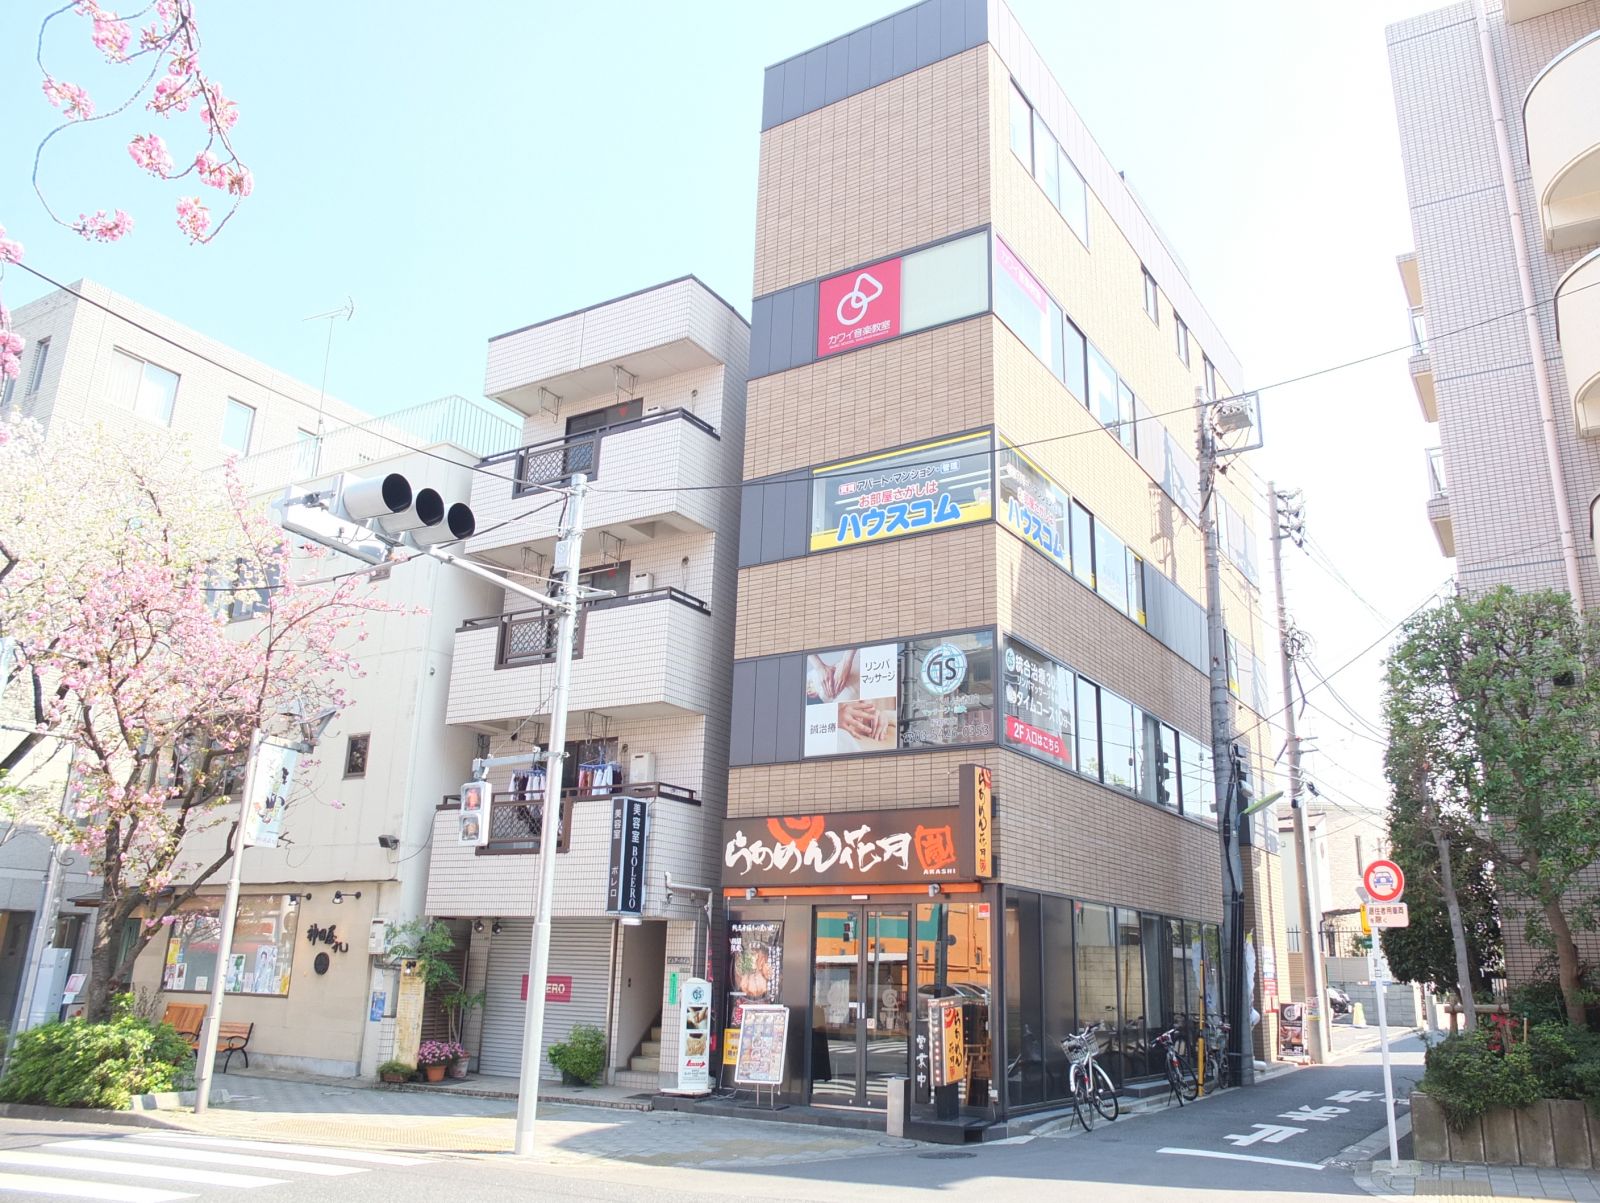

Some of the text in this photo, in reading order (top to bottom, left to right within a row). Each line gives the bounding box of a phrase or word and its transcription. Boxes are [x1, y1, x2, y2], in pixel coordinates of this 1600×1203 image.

[828, 320, 891, 346] カワイ音楽教室
[837, 494, 961, 542] ハウスコム
[859, 481, 938, 507] お部屋さがしは
[861, 671, 896, 684] マッサージ
[1014, 722, 1060, 753] 2F 入口はこちら
[610, 809, 621, 897] 美容室 ボレロ
[628, 803, 641, 909] 美容室 BOLERO
[725, 824, 912, 875] らあめん花月
[916, 1034, 929, 1088] 営業中
